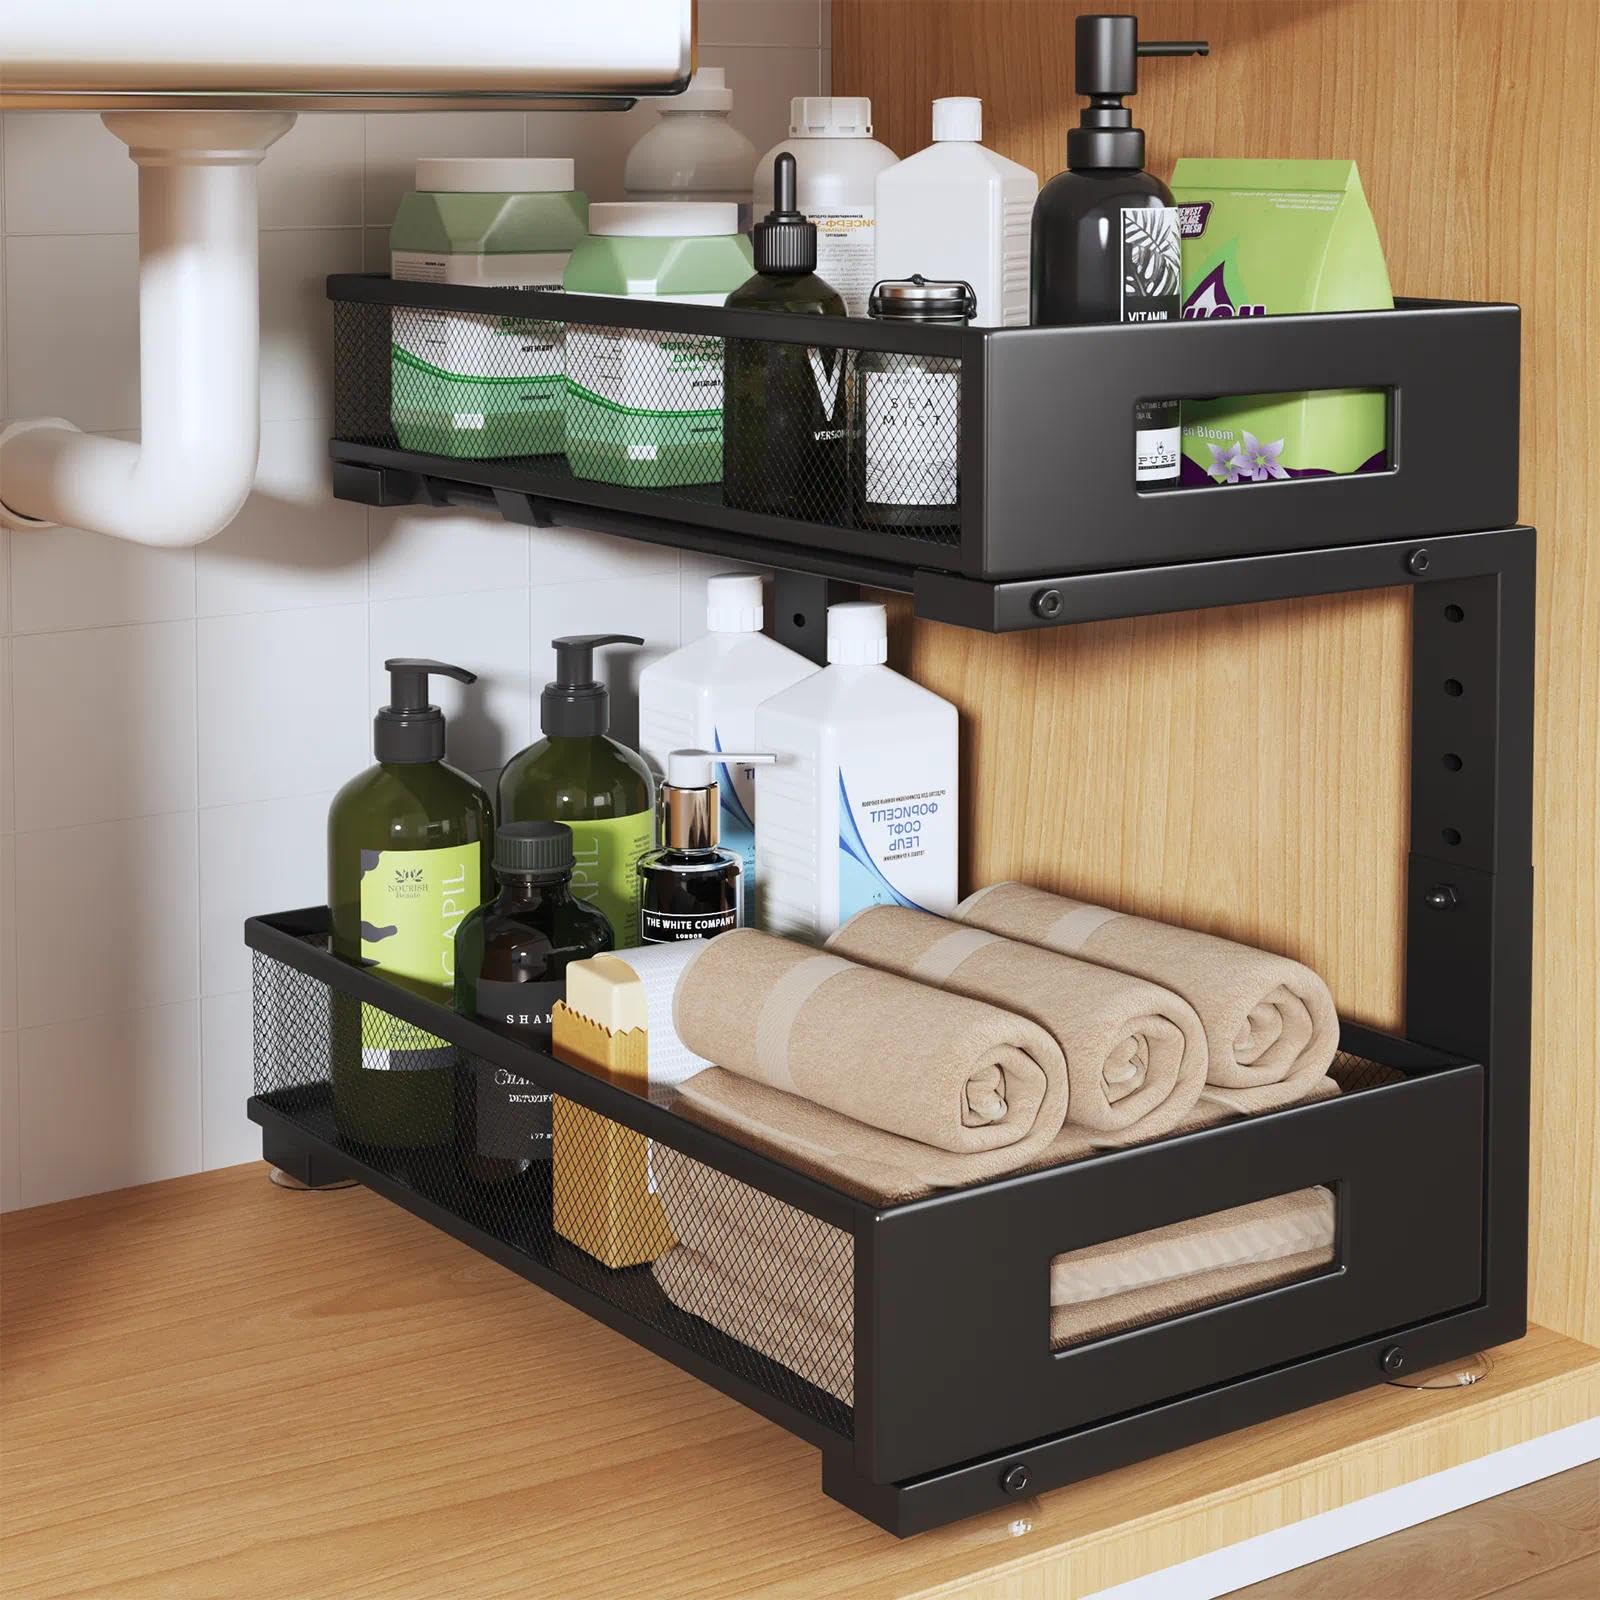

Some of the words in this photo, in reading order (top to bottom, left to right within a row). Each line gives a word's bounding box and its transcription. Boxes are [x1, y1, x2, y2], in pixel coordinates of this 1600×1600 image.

[1128, 311, 1168, 322] VITAMIN
[891, 398, 933, 409] SEA
[883, 415, 941, 427] MIST
[1197, 425, 1234, 440] Bloom
[1138, 454, 1176, 465] PURE
[388, 883, 428, 893] NOURISH
[646, 916, 661, 928] THE
[662, 919, 692, 930] WHITE
[694, 914, 735, 930] COMPANY
